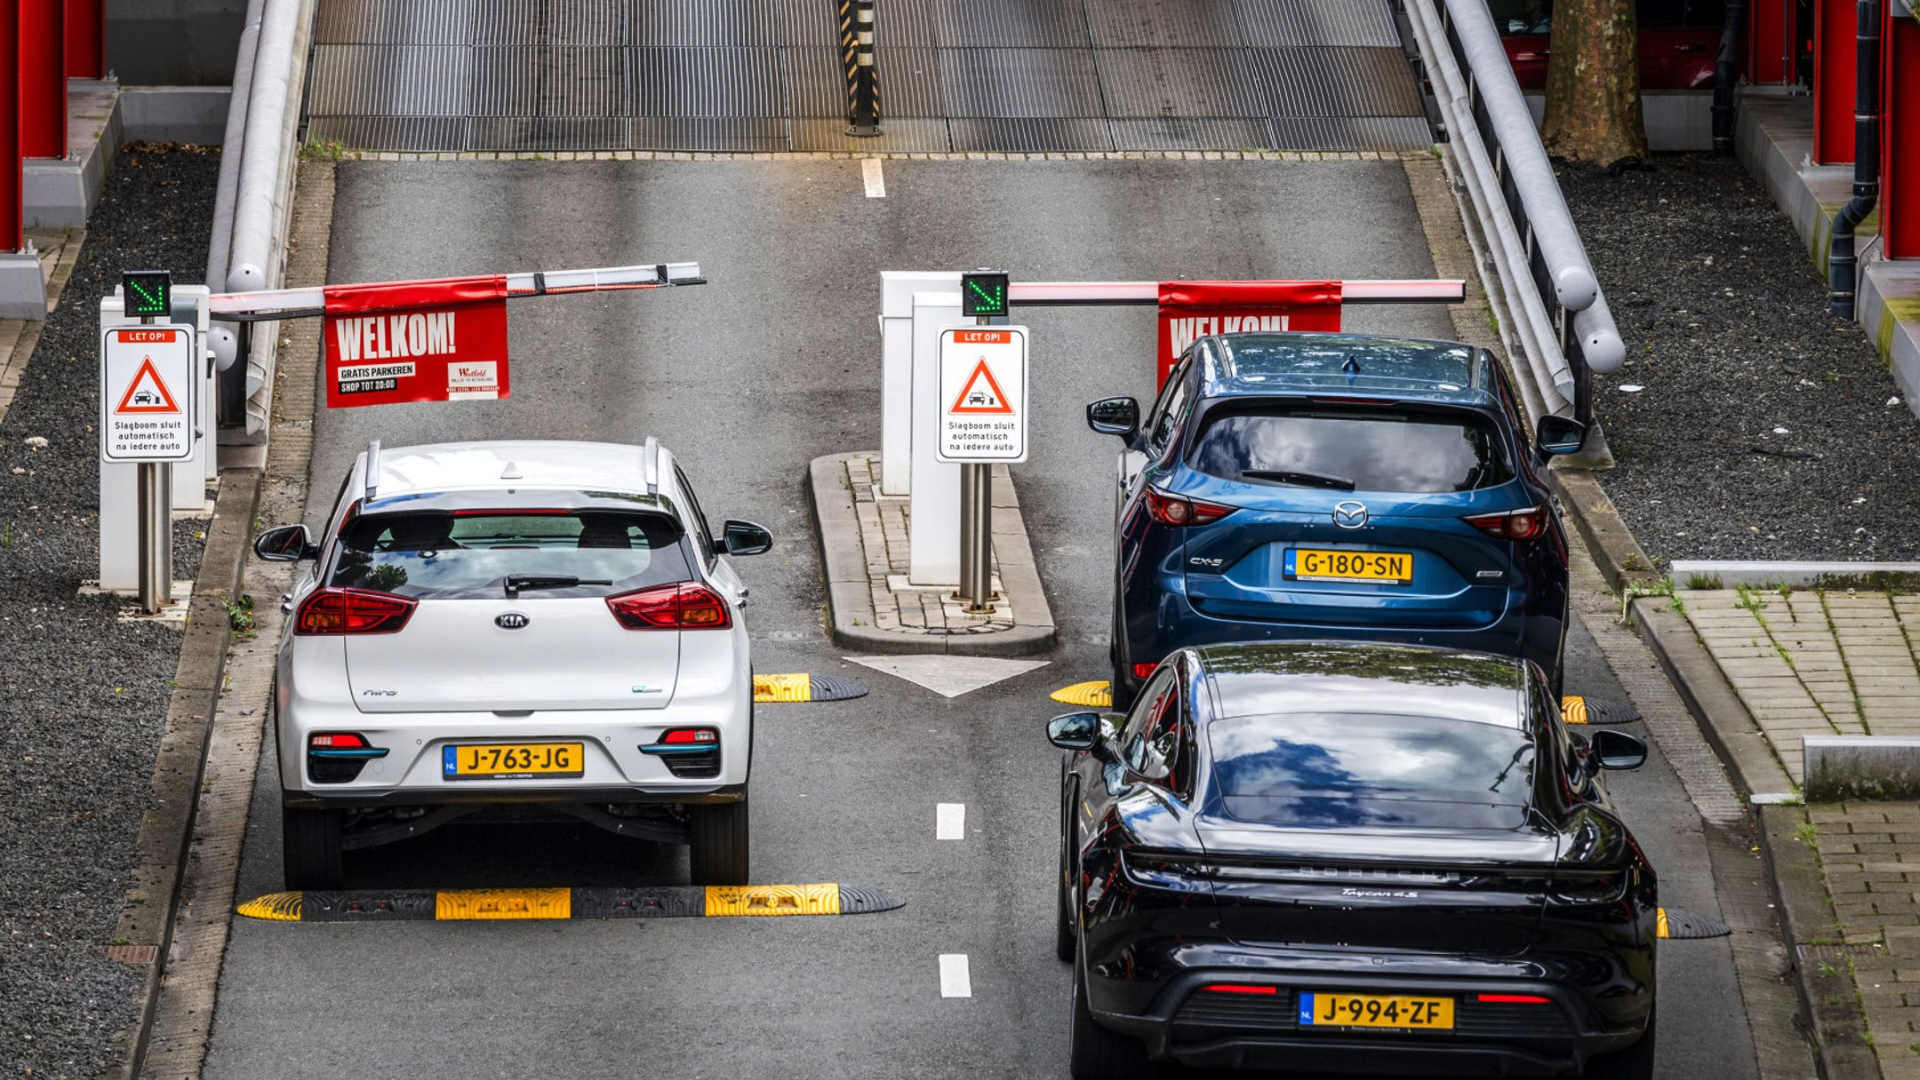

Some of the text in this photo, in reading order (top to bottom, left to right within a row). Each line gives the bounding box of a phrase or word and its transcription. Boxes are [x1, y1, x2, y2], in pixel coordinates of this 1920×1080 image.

[129, 332, 165, 341] LET OP!
[336, 311, 457, 362] WELKOM!
[964, 332, 1000, 341] LET OP!
[341, 365, 413, 379] GRATIS PARKEREN
[341, 379, 395, 392] SHOP TOT 20:00
[114, 421, 181, 430] Slagboom sluit
[948, 421, 1015, 431] Slagboom sluit
[118, 432, 175, 440] automatisch
[952, 432, 1008, 440] automatisch
[130, 442, 157, 450] iedere
[1304, 553, 1403, 576] G-180-SN
[500, 615, 524, 626] KIA
[467, 747, 570, 770] J-763-JG
[445, 762, 456, 770] NL
[1342, 888, 1391, 898] Taycan
[1301, 1011, 1312, 1019] NL
[1323, 998, 1441, 1024] J-994-ZF
